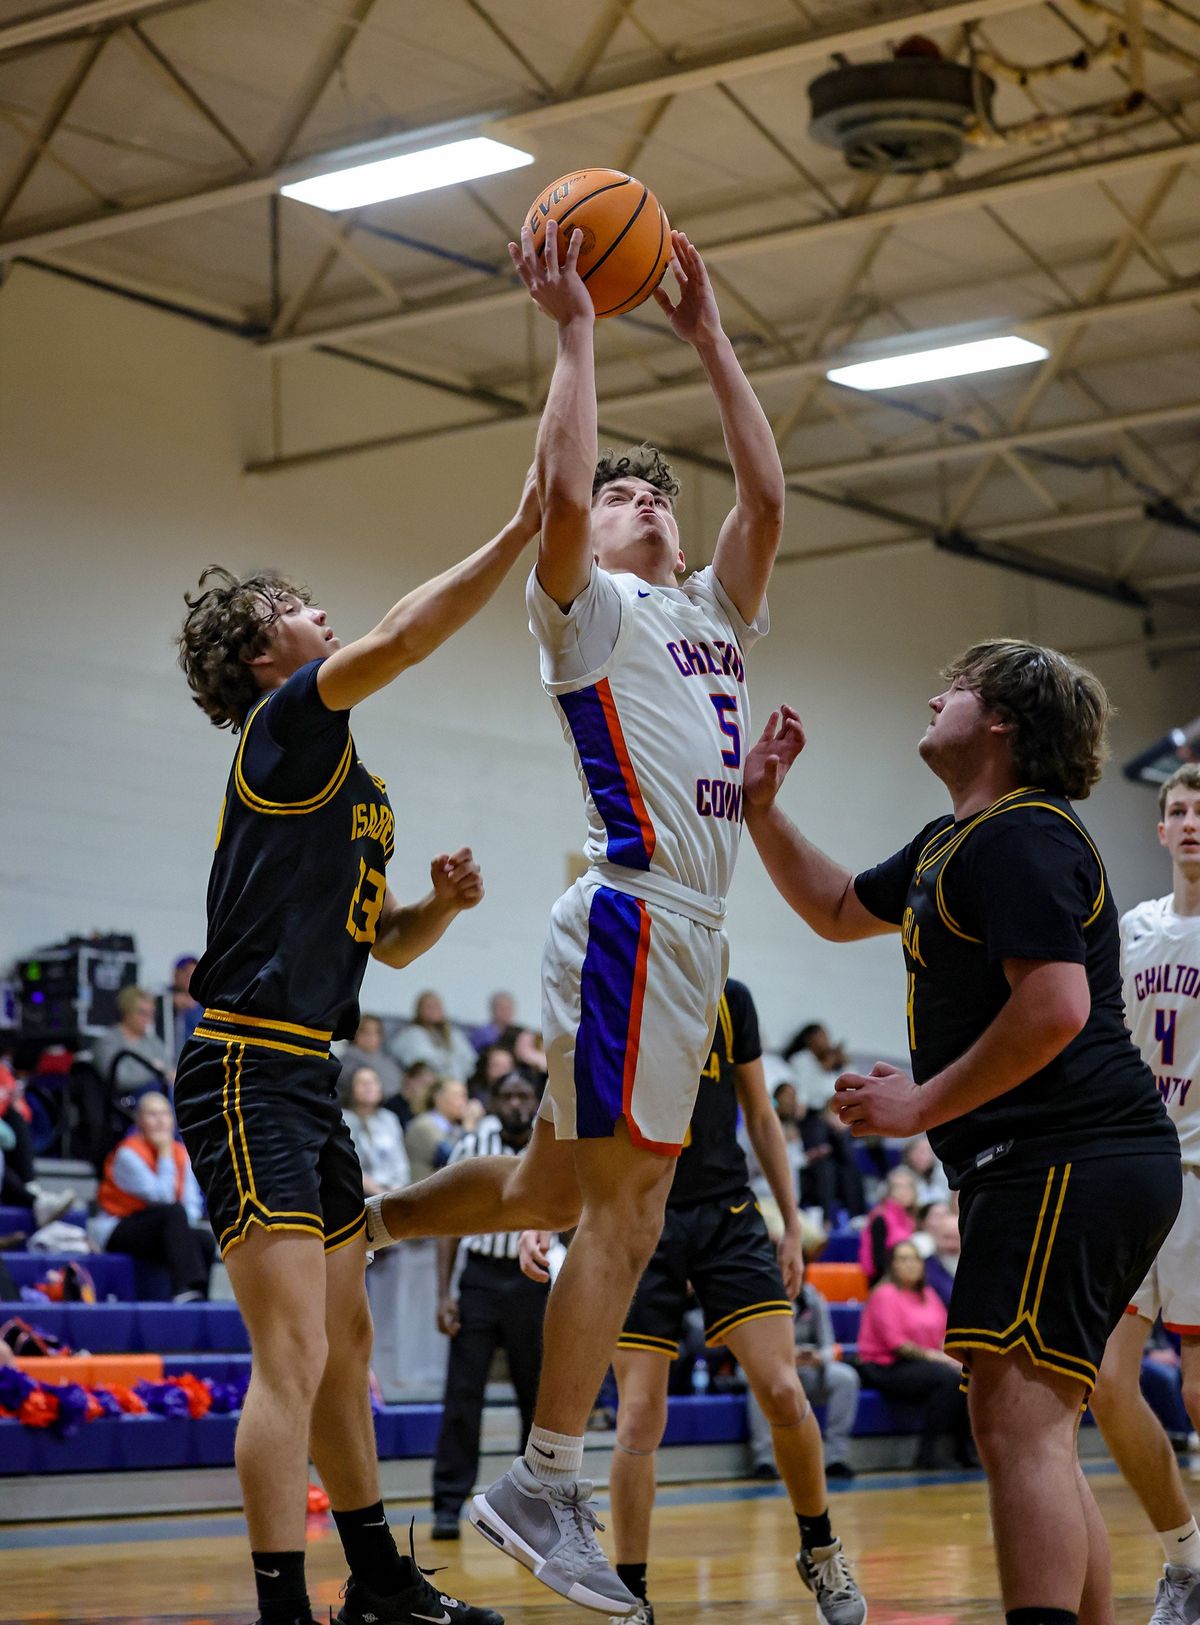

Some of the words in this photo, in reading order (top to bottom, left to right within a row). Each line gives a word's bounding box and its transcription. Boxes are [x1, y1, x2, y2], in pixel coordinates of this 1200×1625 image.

[709, 693, 741, 769] 5
[346, 856, 386, 944] 13
[1155, 1009, 1177, 1065] 4
